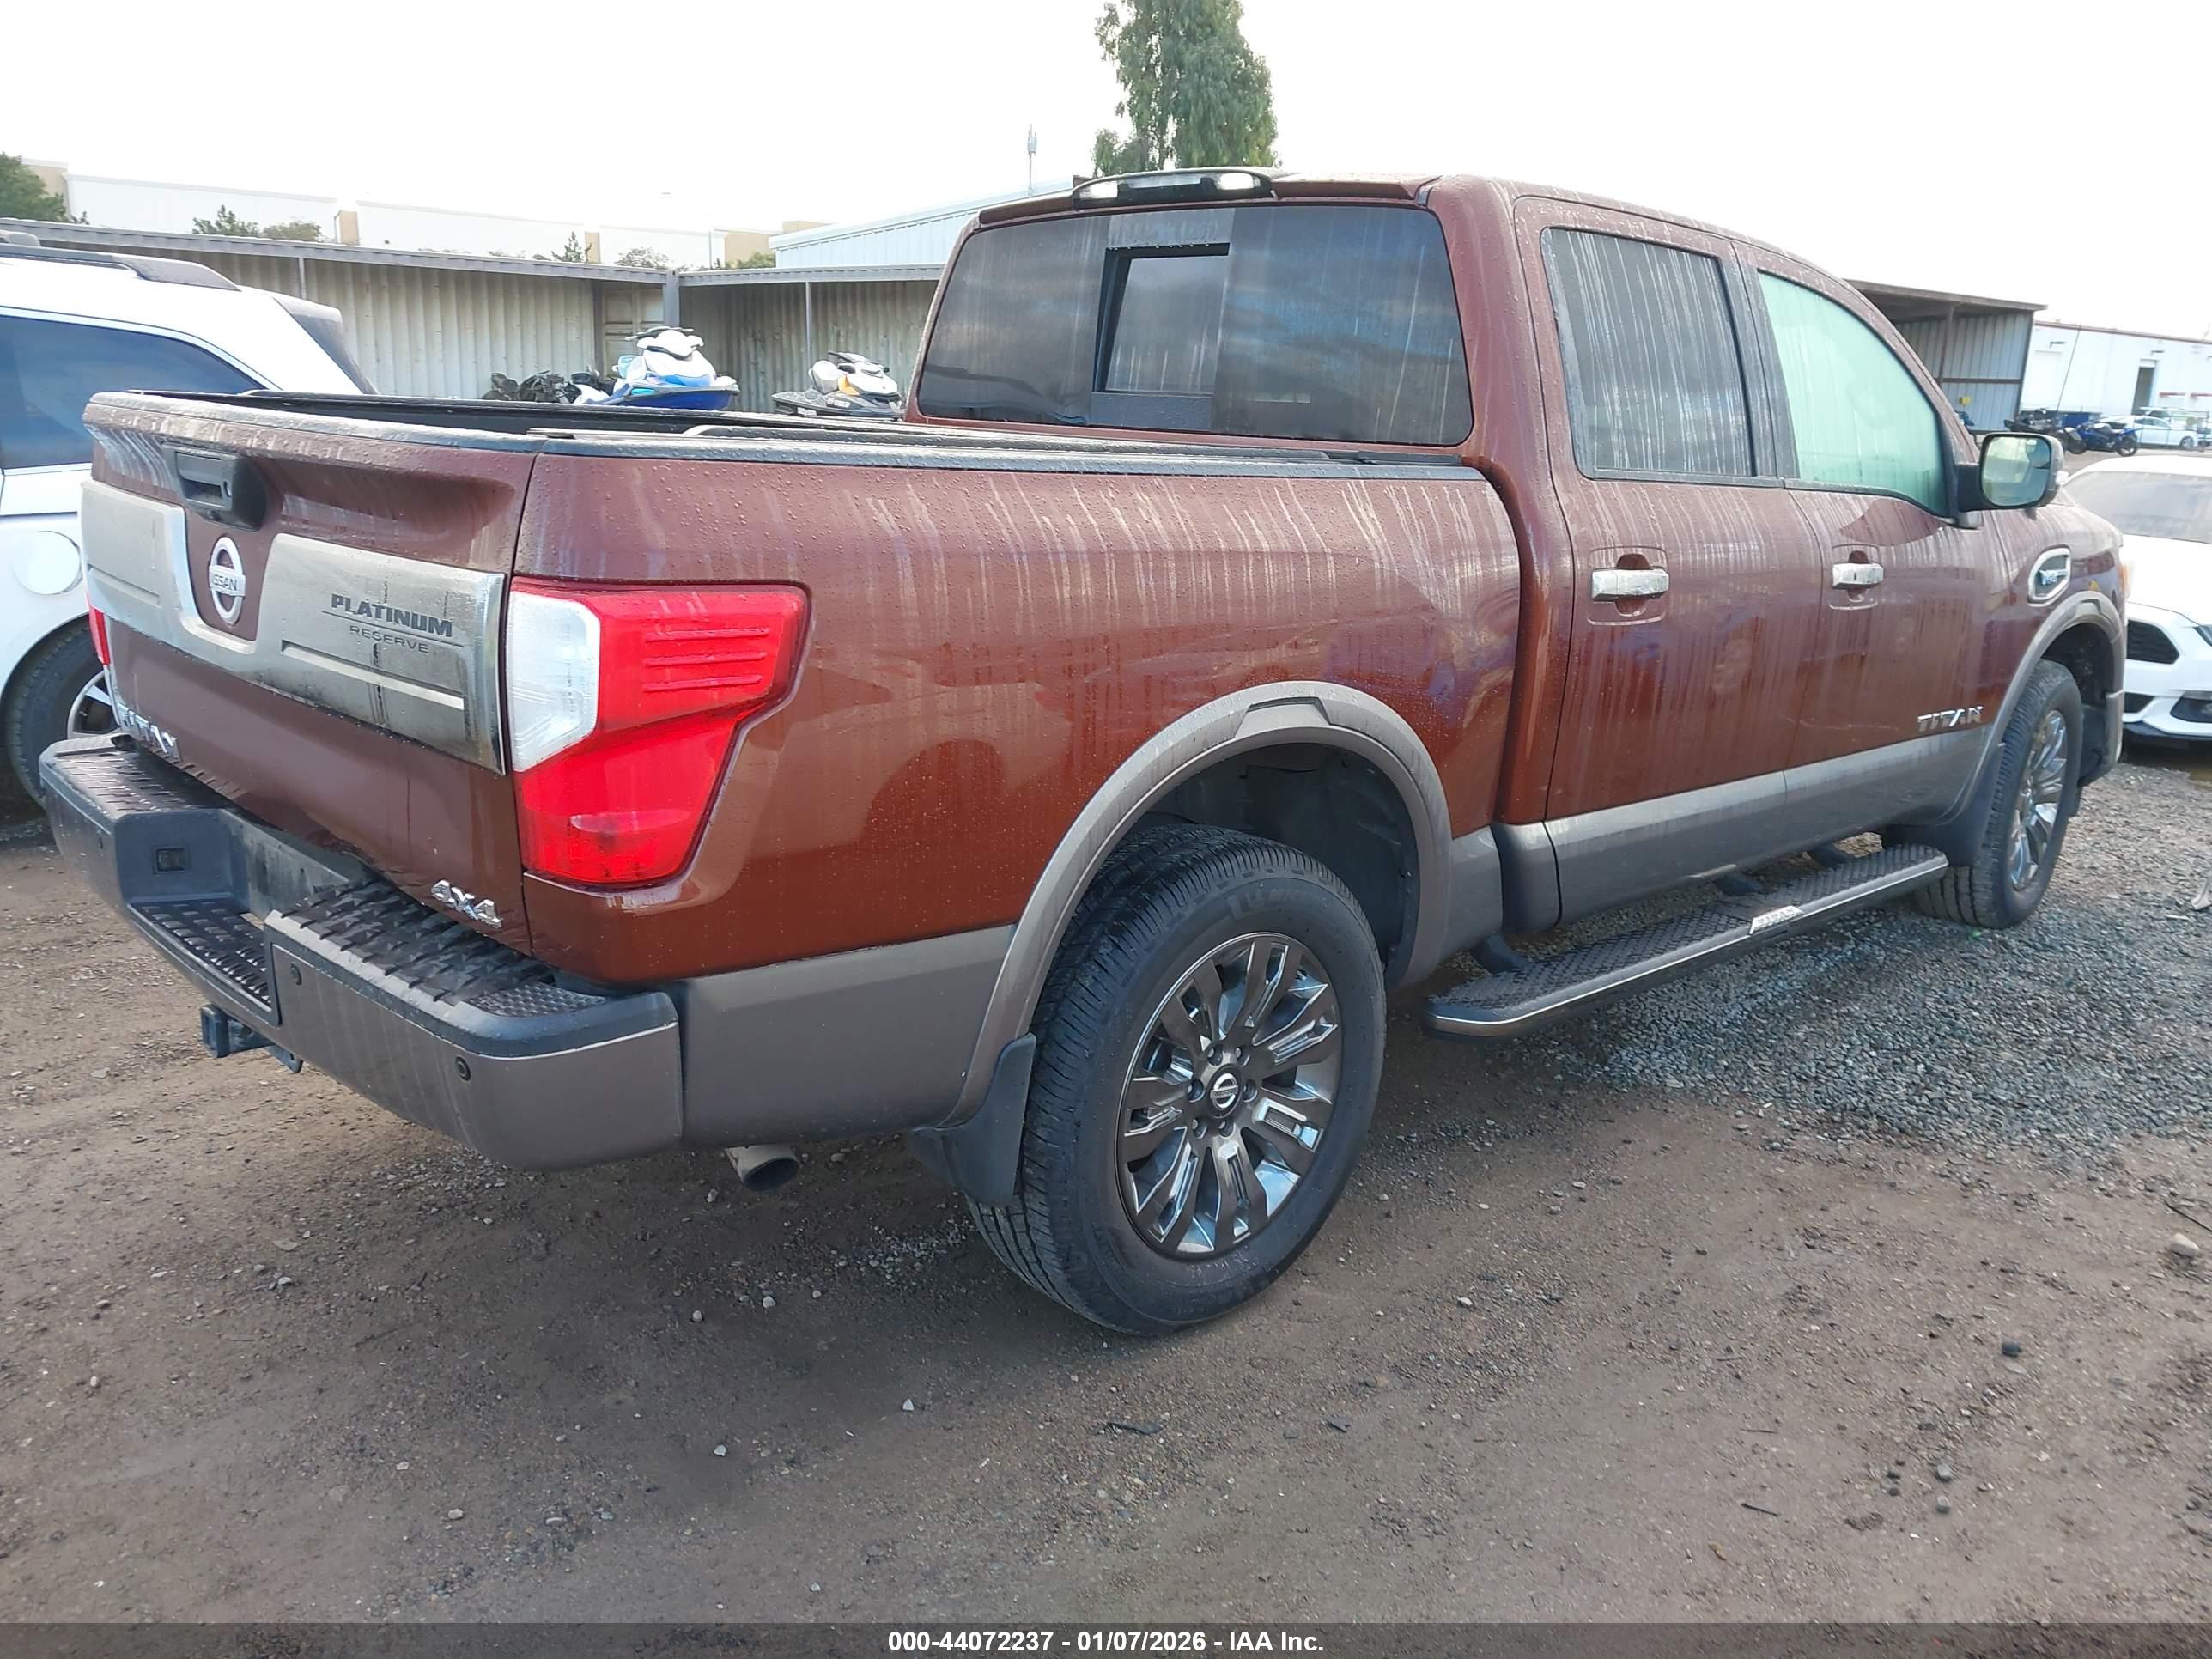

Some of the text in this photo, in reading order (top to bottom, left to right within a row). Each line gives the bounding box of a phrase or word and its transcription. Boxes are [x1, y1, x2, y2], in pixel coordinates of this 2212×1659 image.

[331, 592, 453, 638] PLATINUM
[349, 625, 430, 653] RESERVE
[1917, 705, 1984, 732] TITAN
